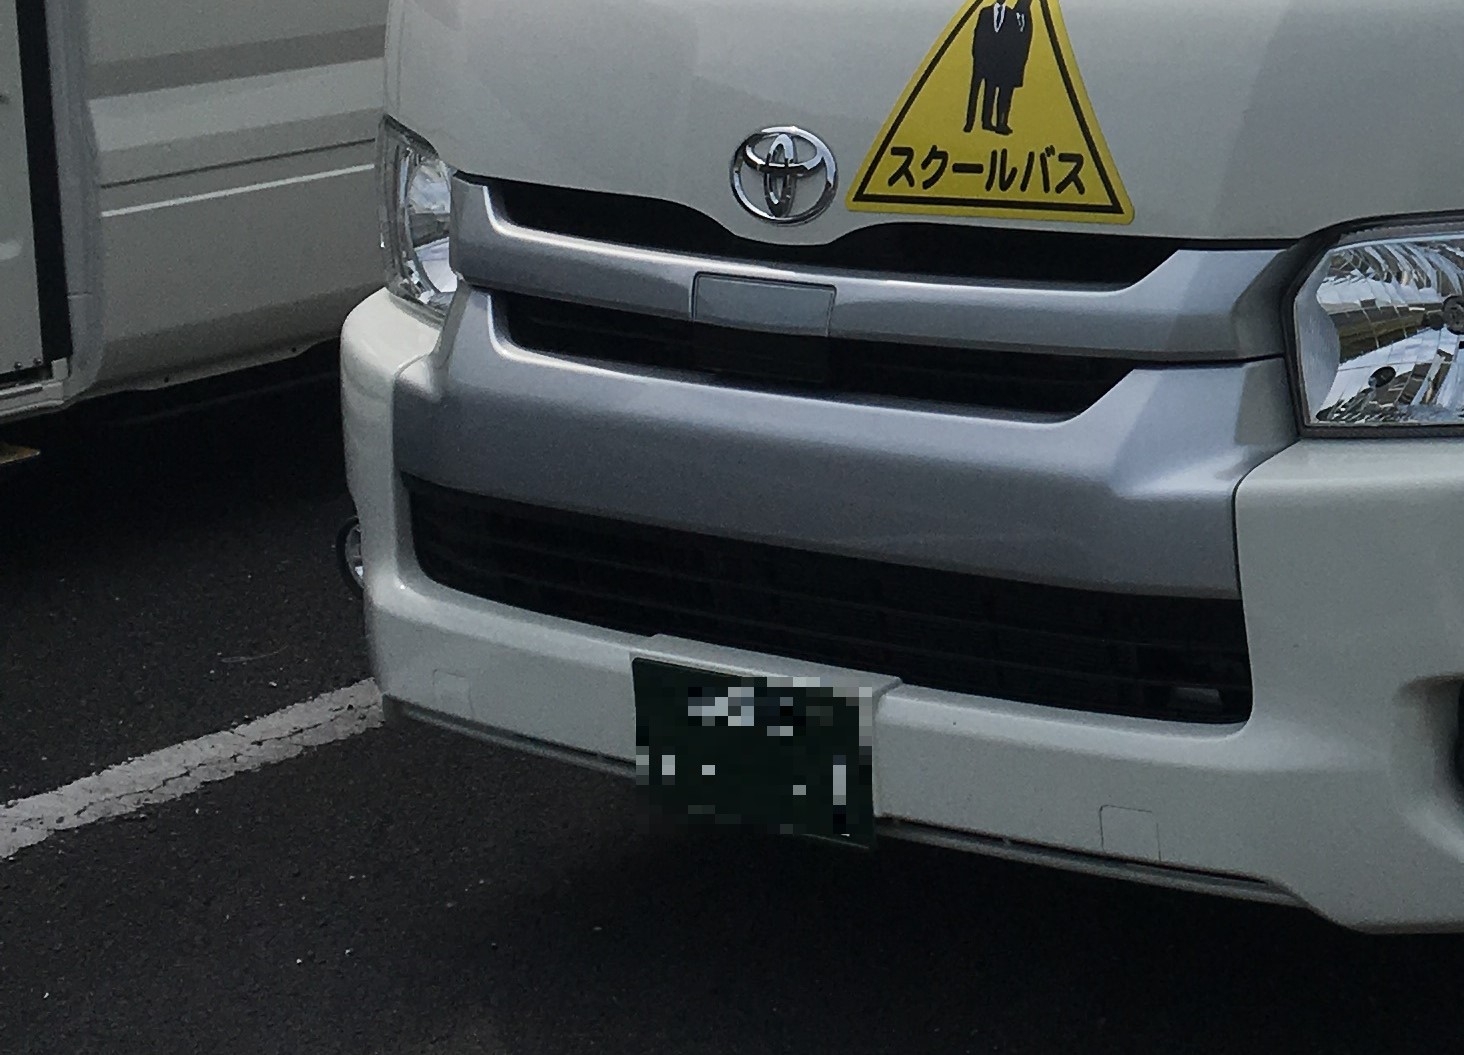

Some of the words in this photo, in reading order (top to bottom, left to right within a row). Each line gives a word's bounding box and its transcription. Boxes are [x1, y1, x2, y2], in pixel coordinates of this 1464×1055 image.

[887, 144, 1086, 195] スクールバス
